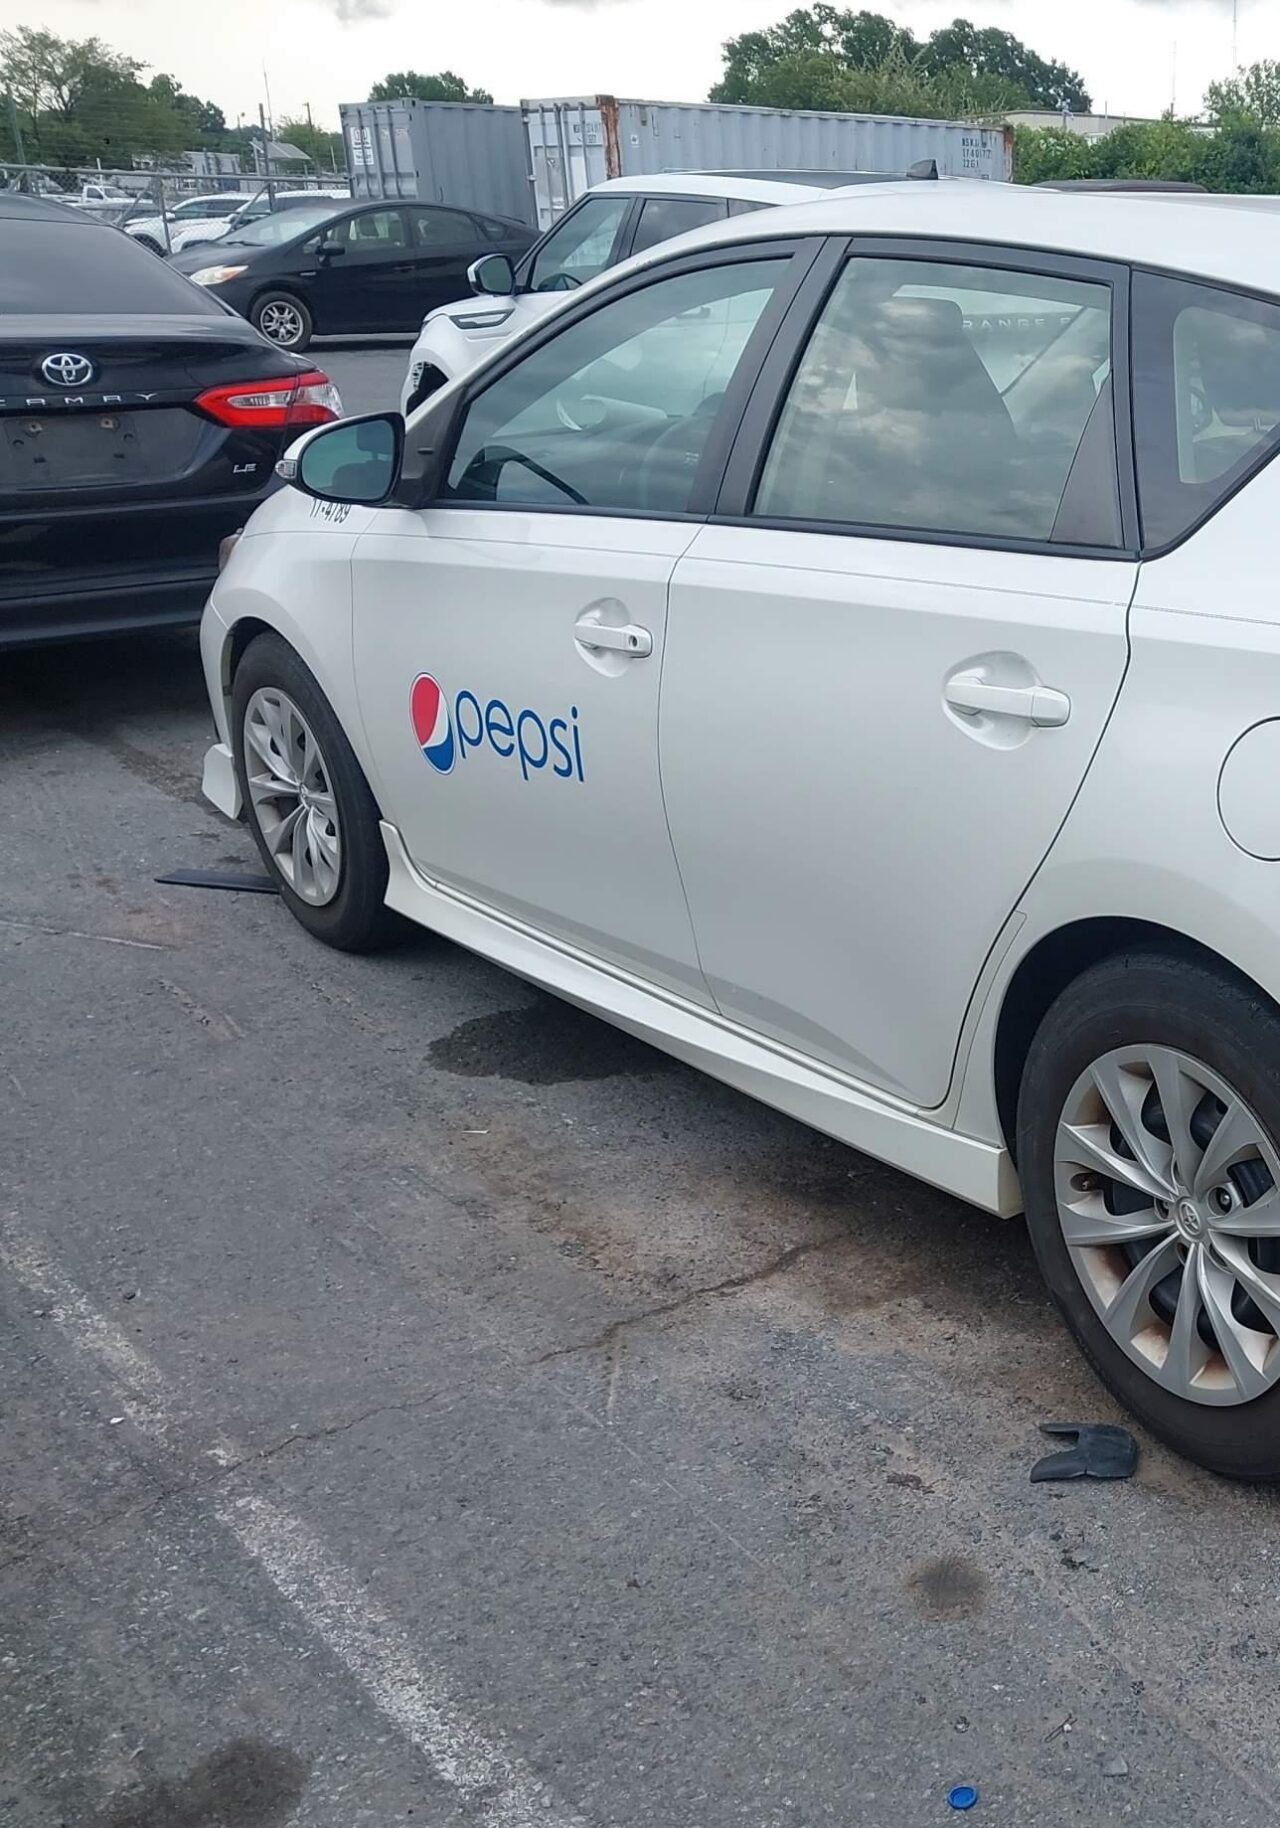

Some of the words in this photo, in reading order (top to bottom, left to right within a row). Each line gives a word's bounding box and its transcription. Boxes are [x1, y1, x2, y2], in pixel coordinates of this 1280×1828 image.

[0, 393, 157, 407] AMRY
[233, 463, 257, 474] LE
[455, 690, 584, 782] pepsi
